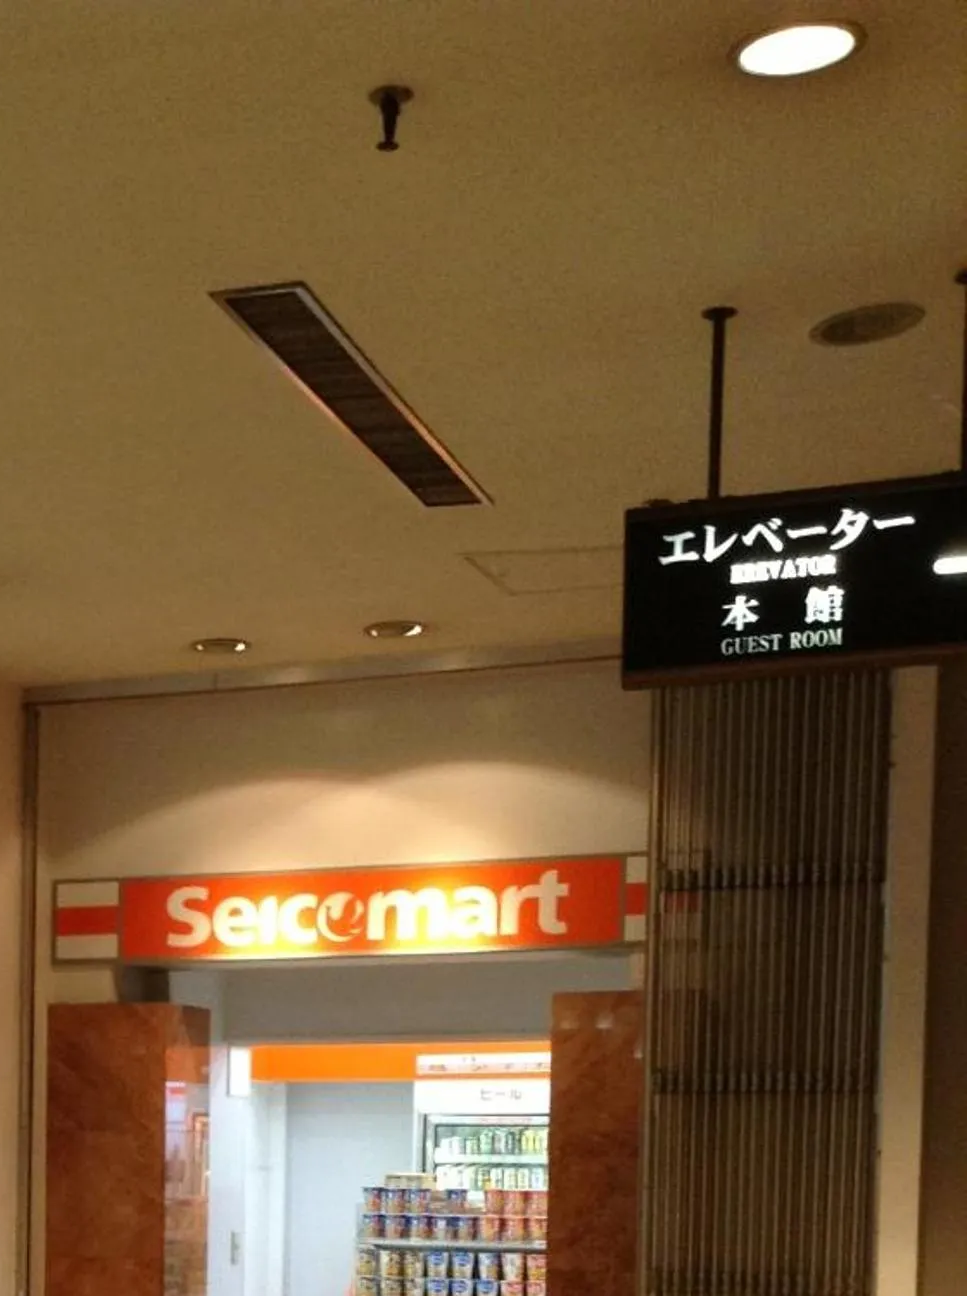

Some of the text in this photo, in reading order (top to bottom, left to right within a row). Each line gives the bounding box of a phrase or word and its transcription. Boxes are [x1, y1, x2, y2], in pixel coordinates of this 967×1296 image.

[659, 508, 916, 566] エレベーター
[720, 628, 844, 655] GUEST ROOM
[165, 870, 568, 947] Seicomart
